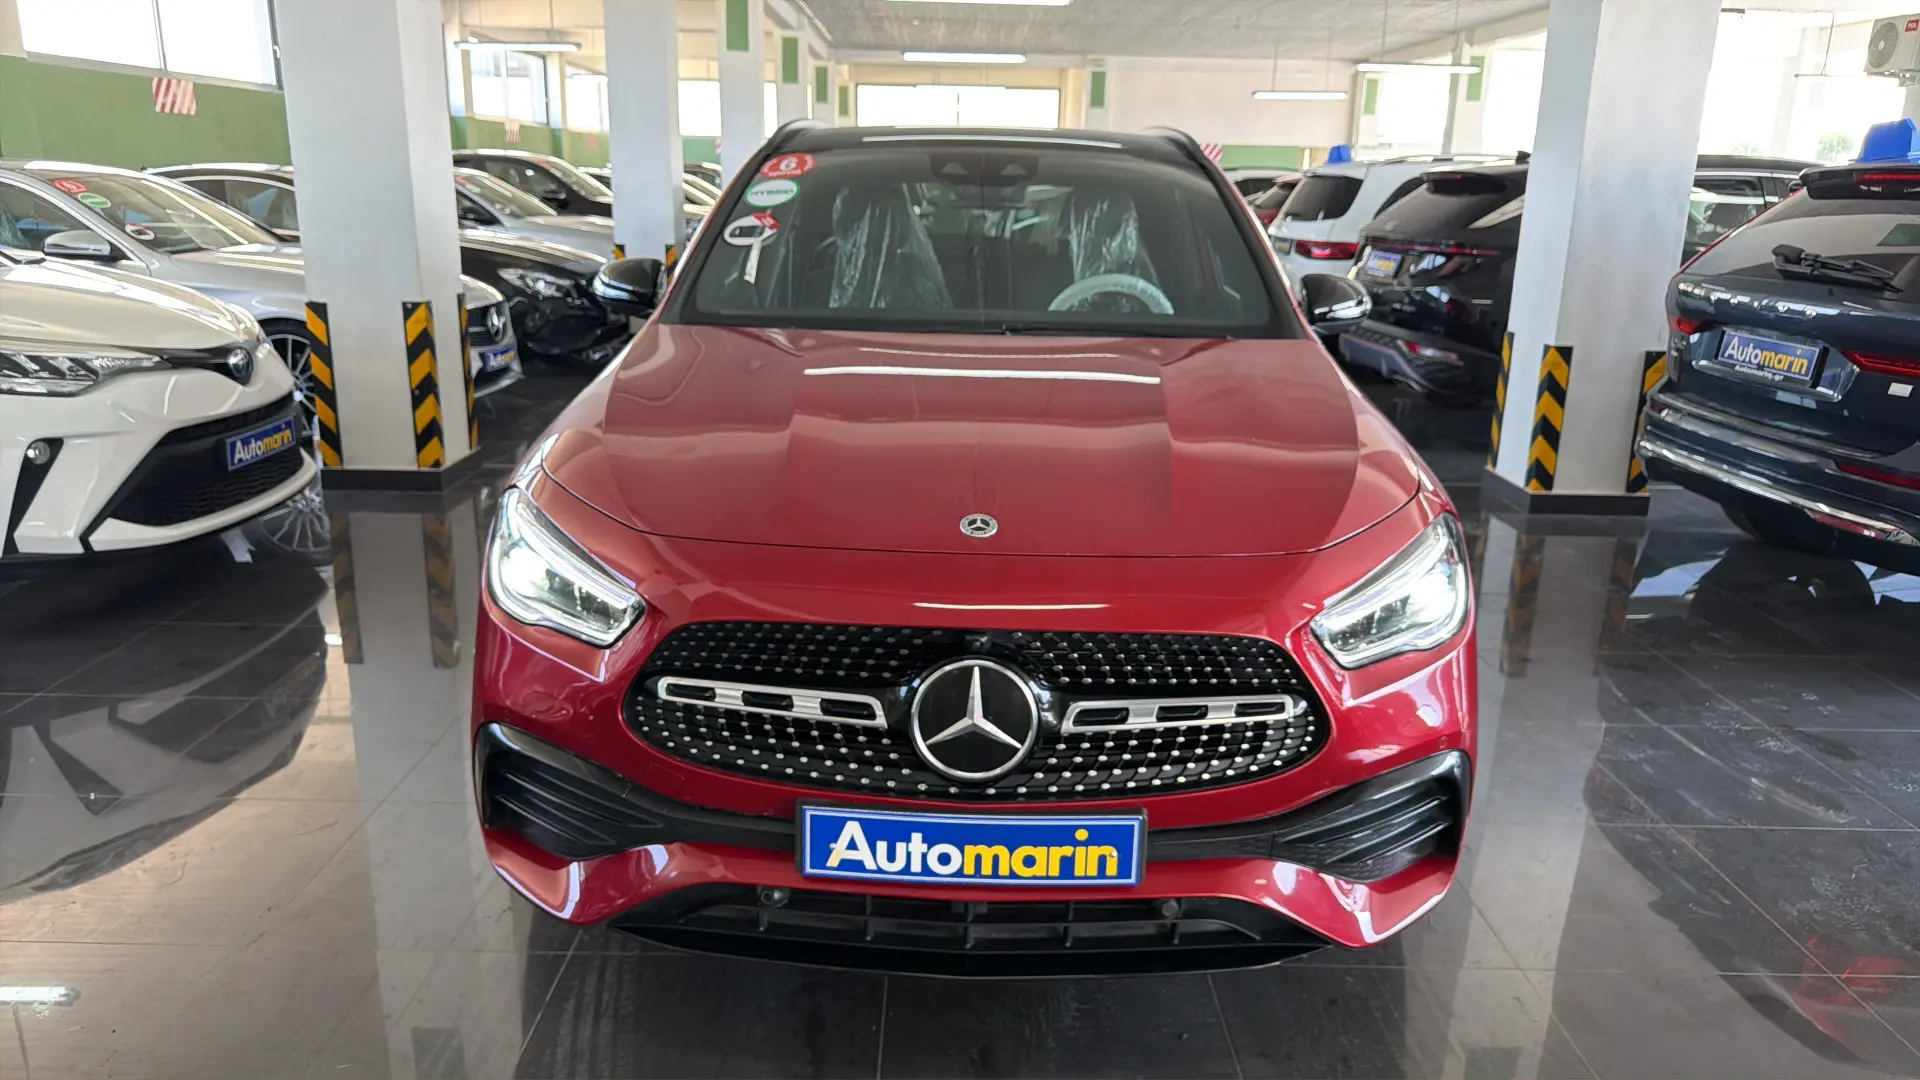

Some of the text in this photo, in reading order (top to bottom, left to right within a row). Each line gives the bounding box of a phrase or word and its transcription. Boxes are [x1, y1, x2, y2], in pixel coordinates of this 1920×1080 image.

[779, 156, 799, 171] 6
[1723, 336, 1808, 374] Automarin
[234, 423, 292, 465] Automarin
[826, 820, 1119, 877] Automarin
